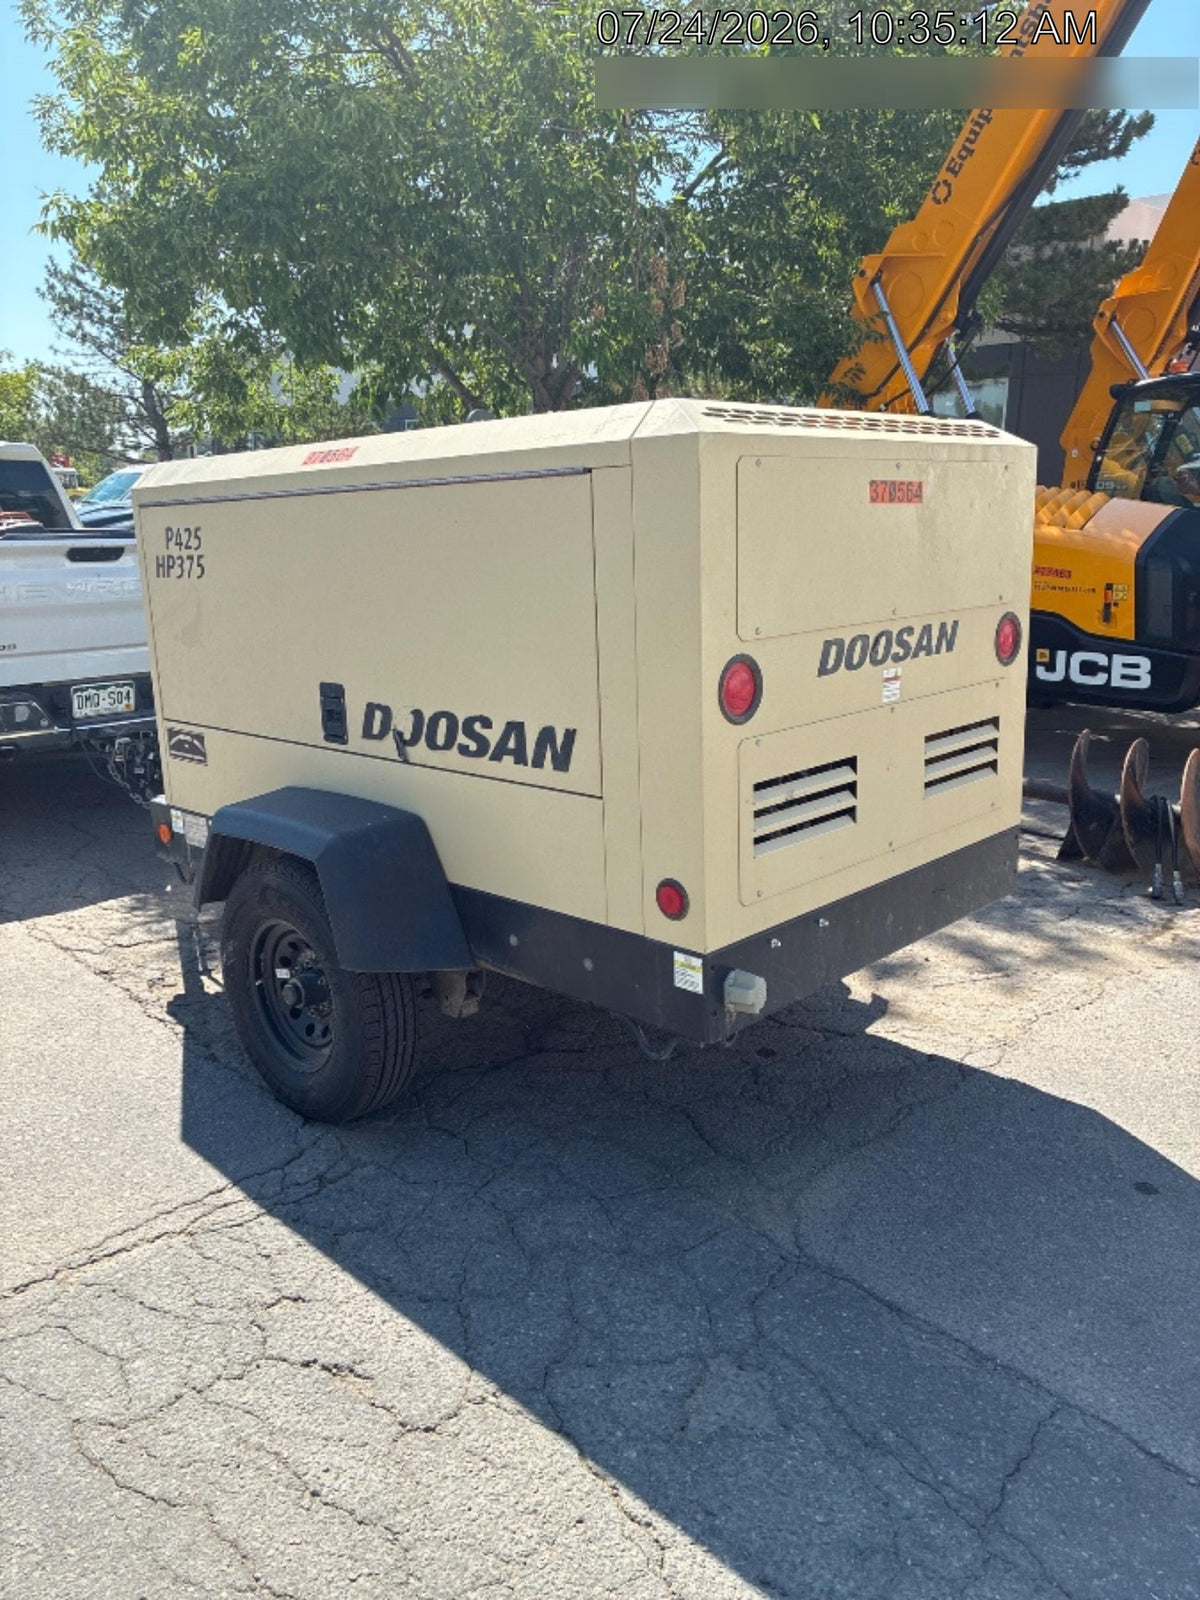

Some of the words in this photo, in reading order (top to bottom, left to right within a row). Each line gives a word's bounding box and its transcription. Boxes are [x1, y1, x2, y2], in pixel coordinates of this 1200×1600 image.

[165, 527, 201, 551] P425
[156, 555, 205, 579] HP375
[817, 620, 959, 677] DOOSAN
[1036, 650, 1151, 689] JCB
